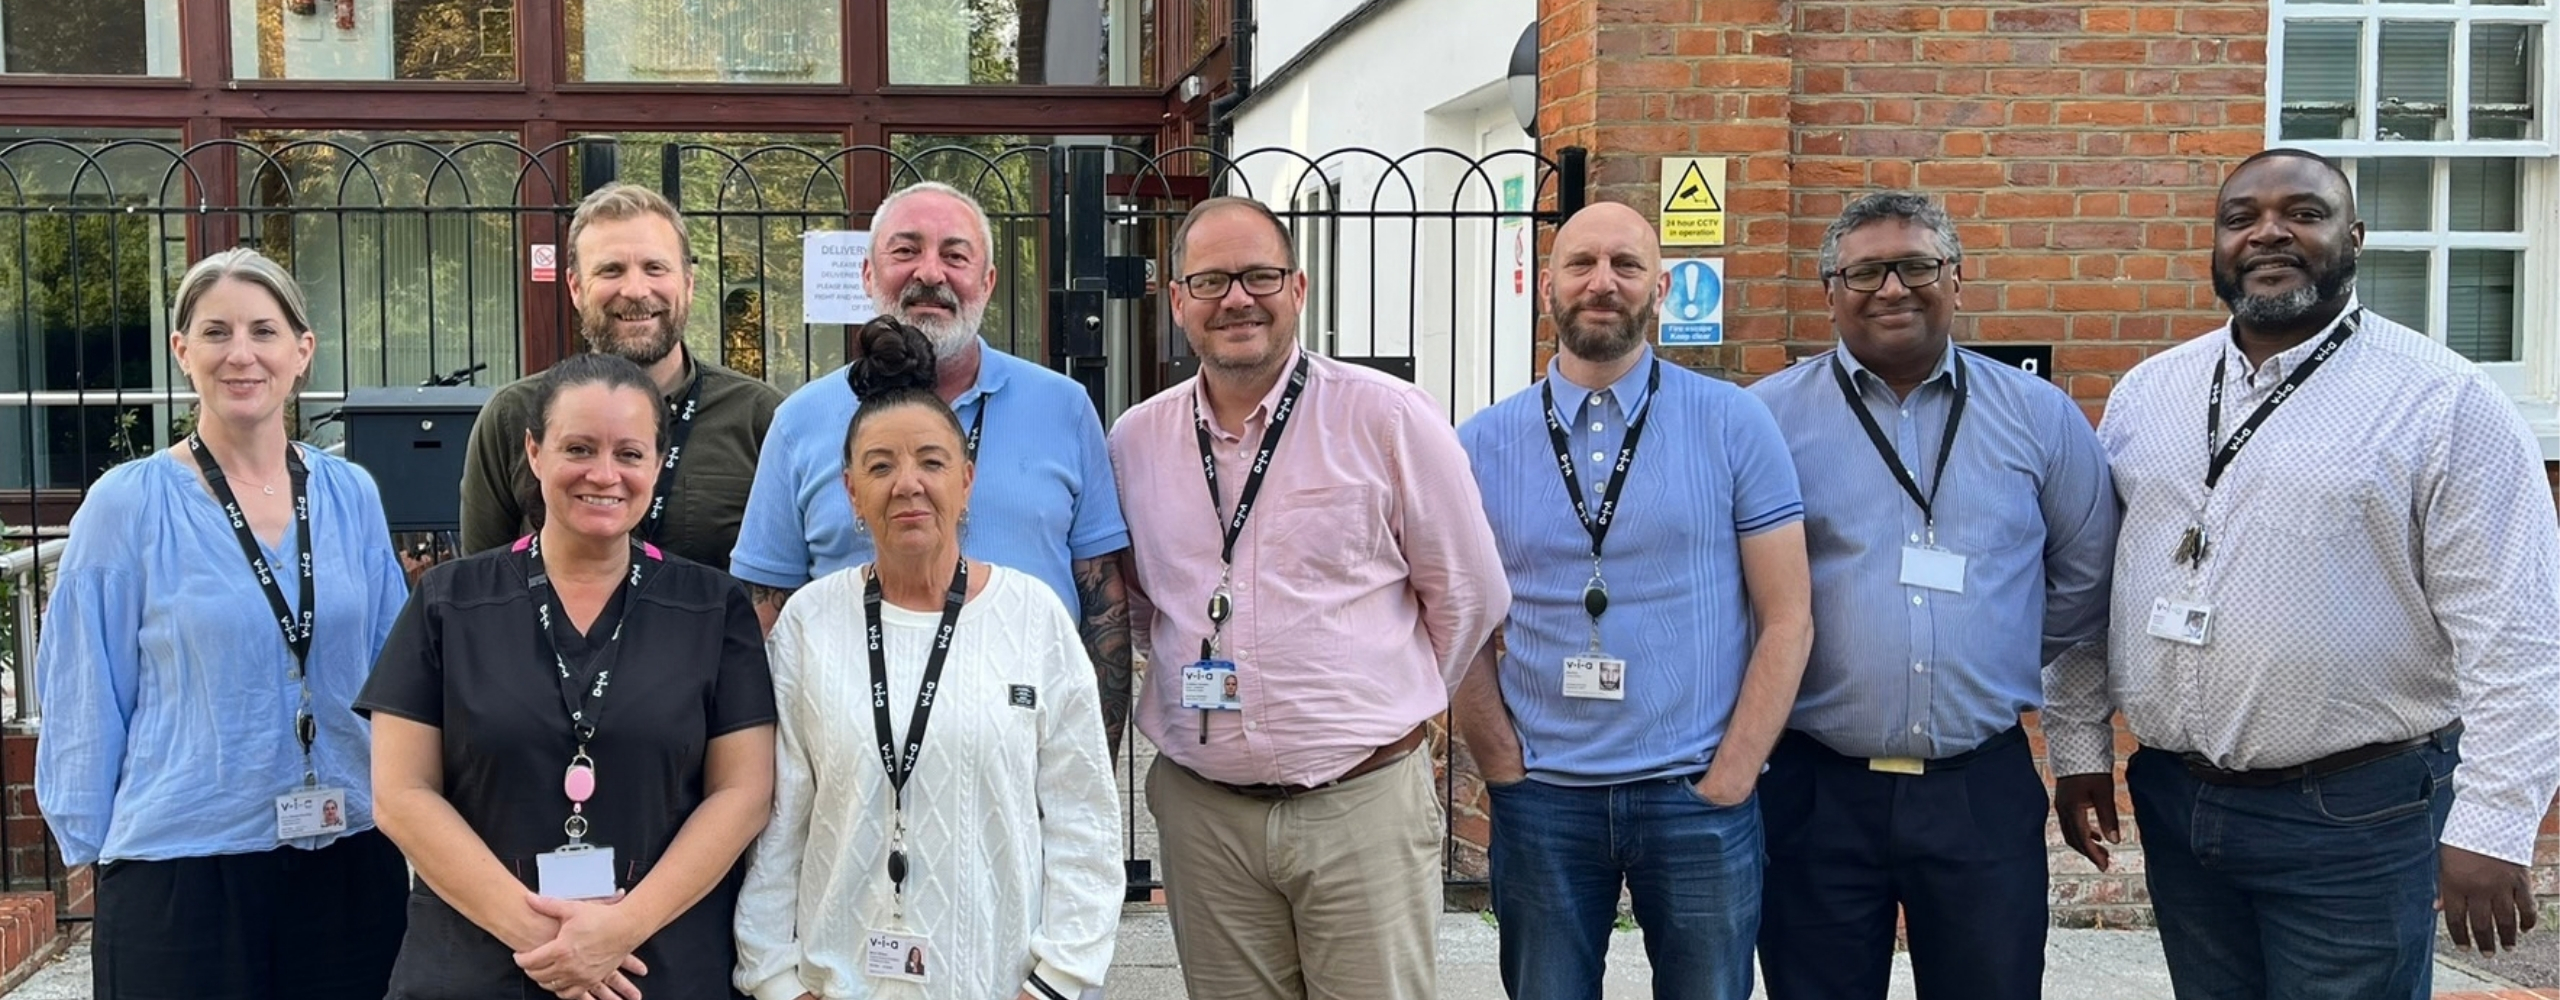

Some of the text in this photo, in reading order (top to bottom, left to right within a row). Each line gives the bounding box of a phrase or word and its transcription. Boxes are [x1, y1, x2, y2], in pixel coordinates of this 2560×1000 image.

[1666, 219, 1719, 227] 24 hour CCTV
[1679, 229, 1715, 237] operation
